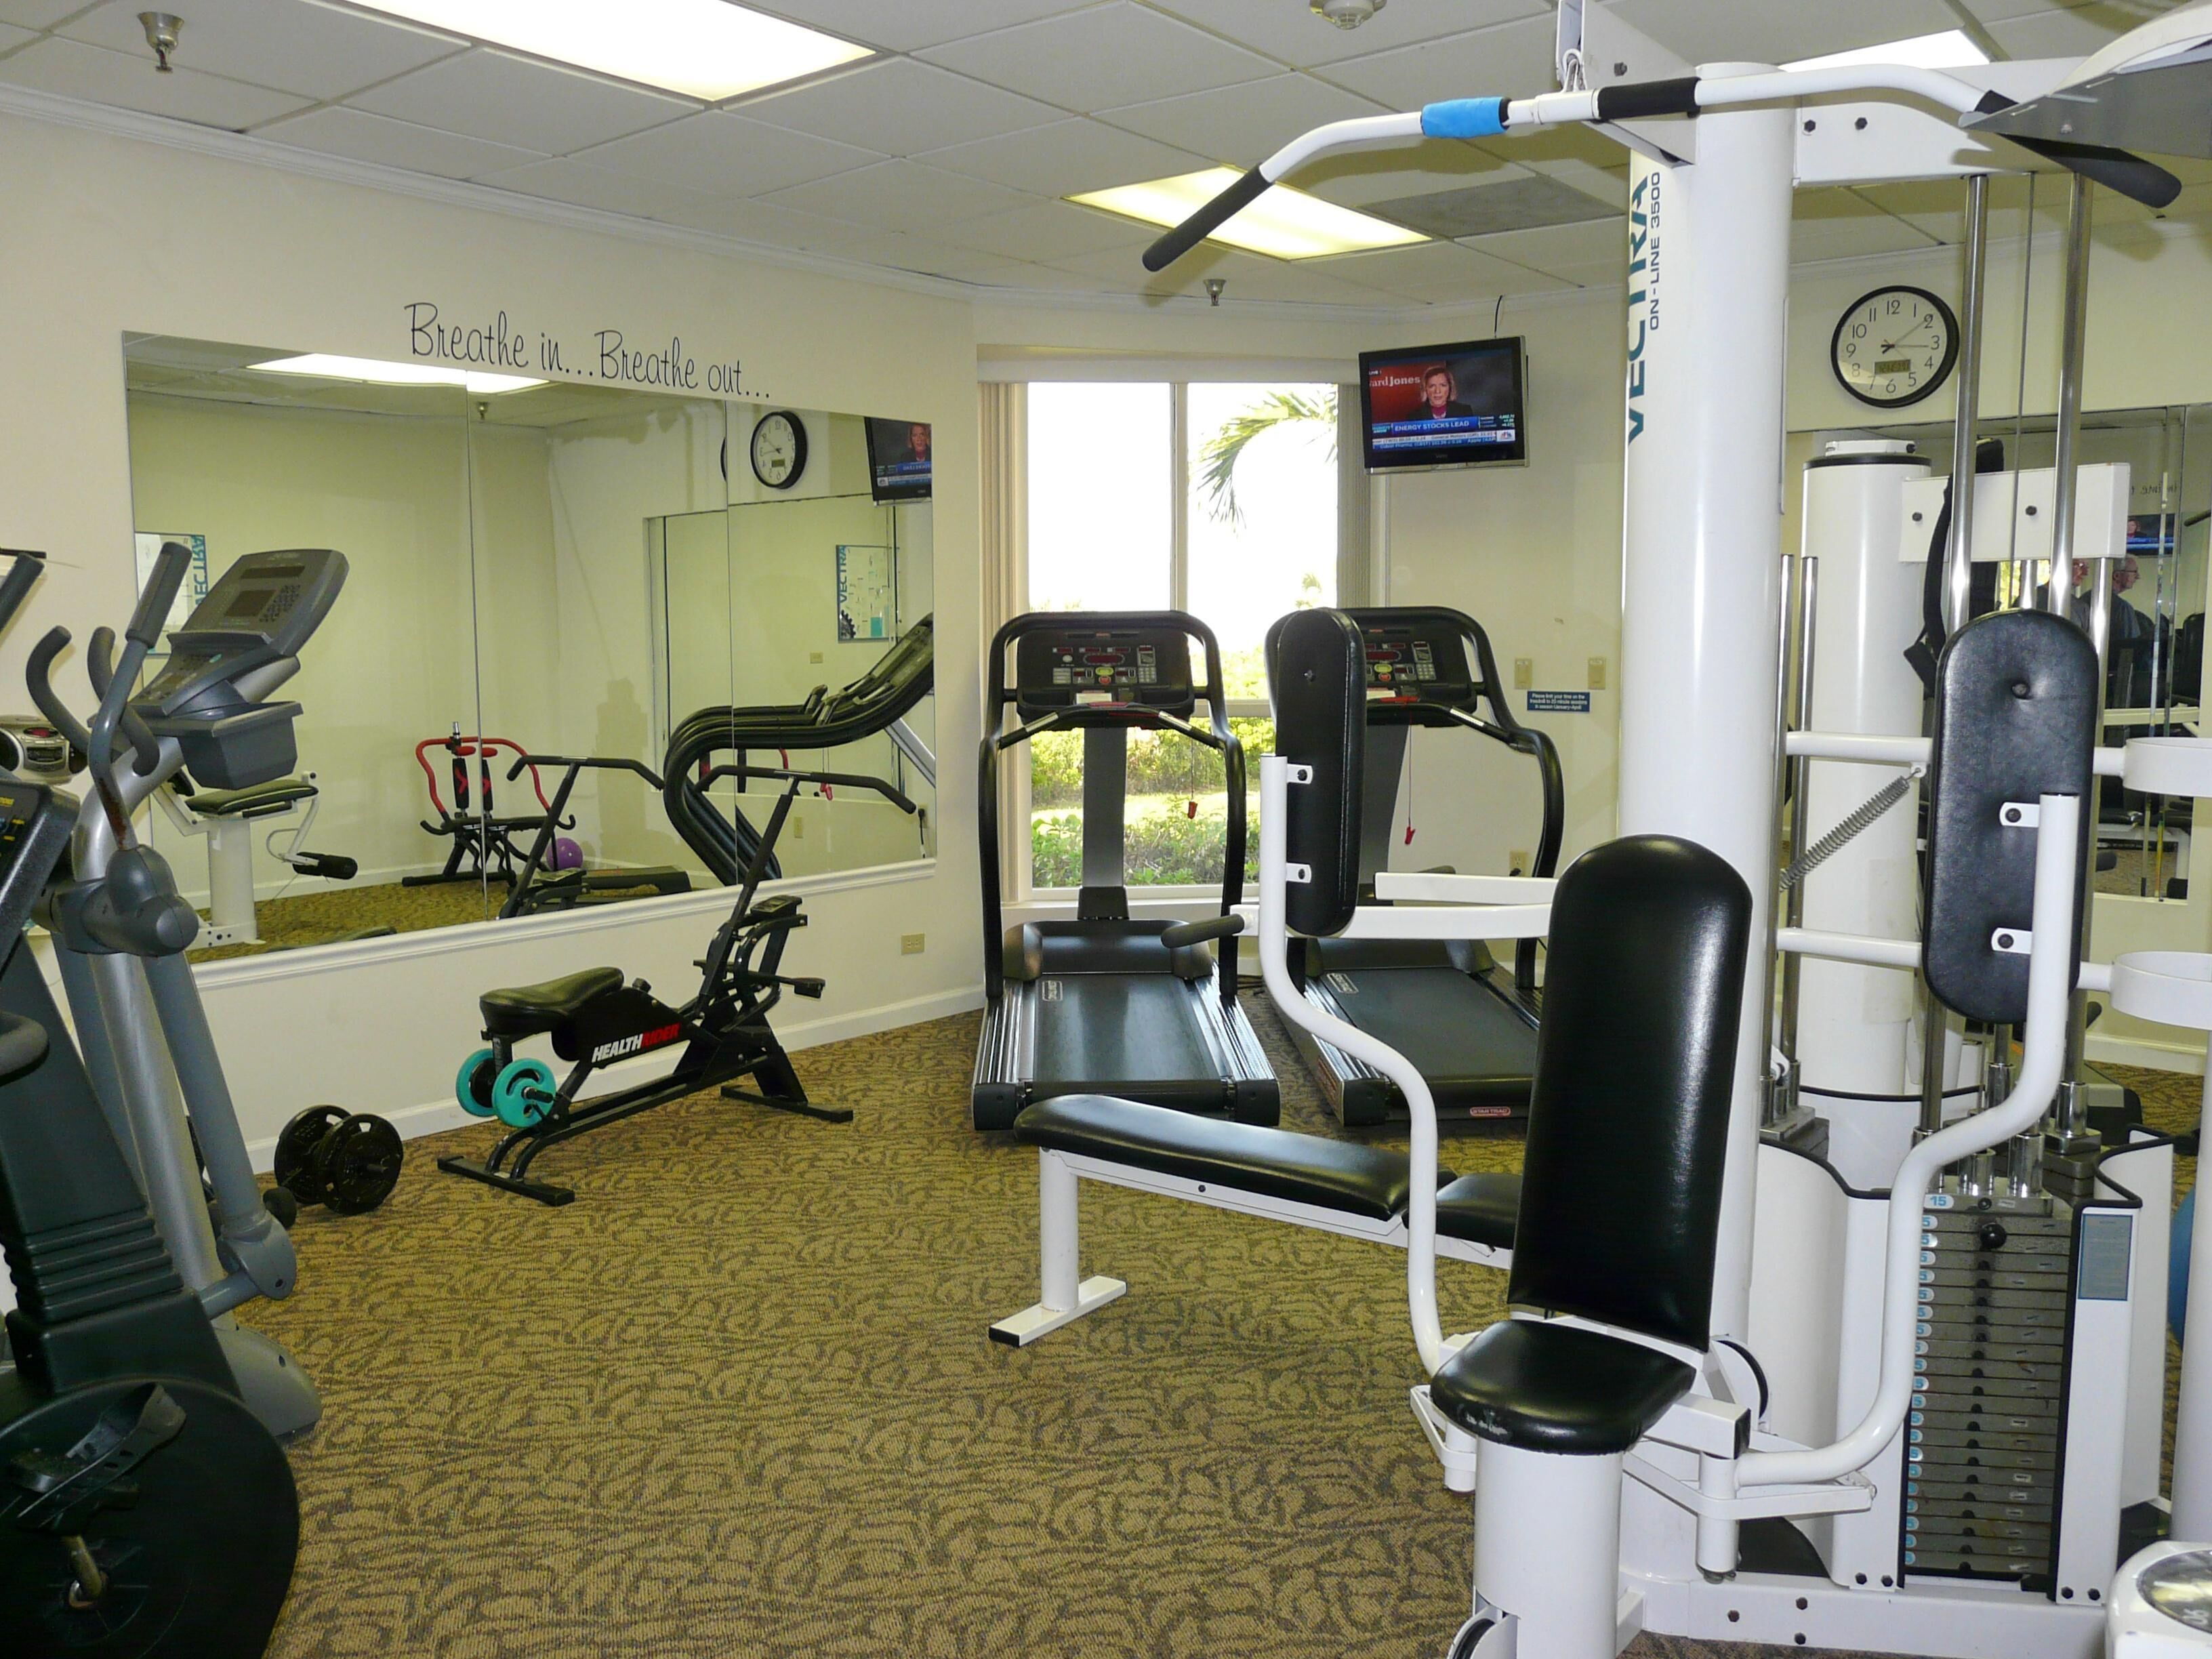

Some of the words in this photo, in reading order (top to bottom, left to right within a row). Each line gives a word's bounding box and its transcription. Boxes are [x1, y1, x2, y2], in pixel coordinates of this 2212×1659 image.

[1651, 171, 1660, 228] 3500
[1869, 308, 1877, 322] 11
[1886, 300, 1900, 315] 12
[1913, 303, 1917, 318] 1
[1924, 314, 1934, 329] 2
[1851, 323, 1867, 339] 10
[404, 302, 529, 367] Breathe
[594, 329, 699, 390] Breathe
[1931, 335, 1940, 350] 3
[1846, 343, 1856, 358] 9
[1851, 363, 1860, 377] 8
[1924, 356, 1934, 369] 4
[1389, 375, 1420, 387] Jones
[1868, 375, 1877, 390] 7
[1886, 379, 1896, 394] 6
[1908, 372, 1917, 387] 5
[1930, 1196, 1946, 1206] 15
